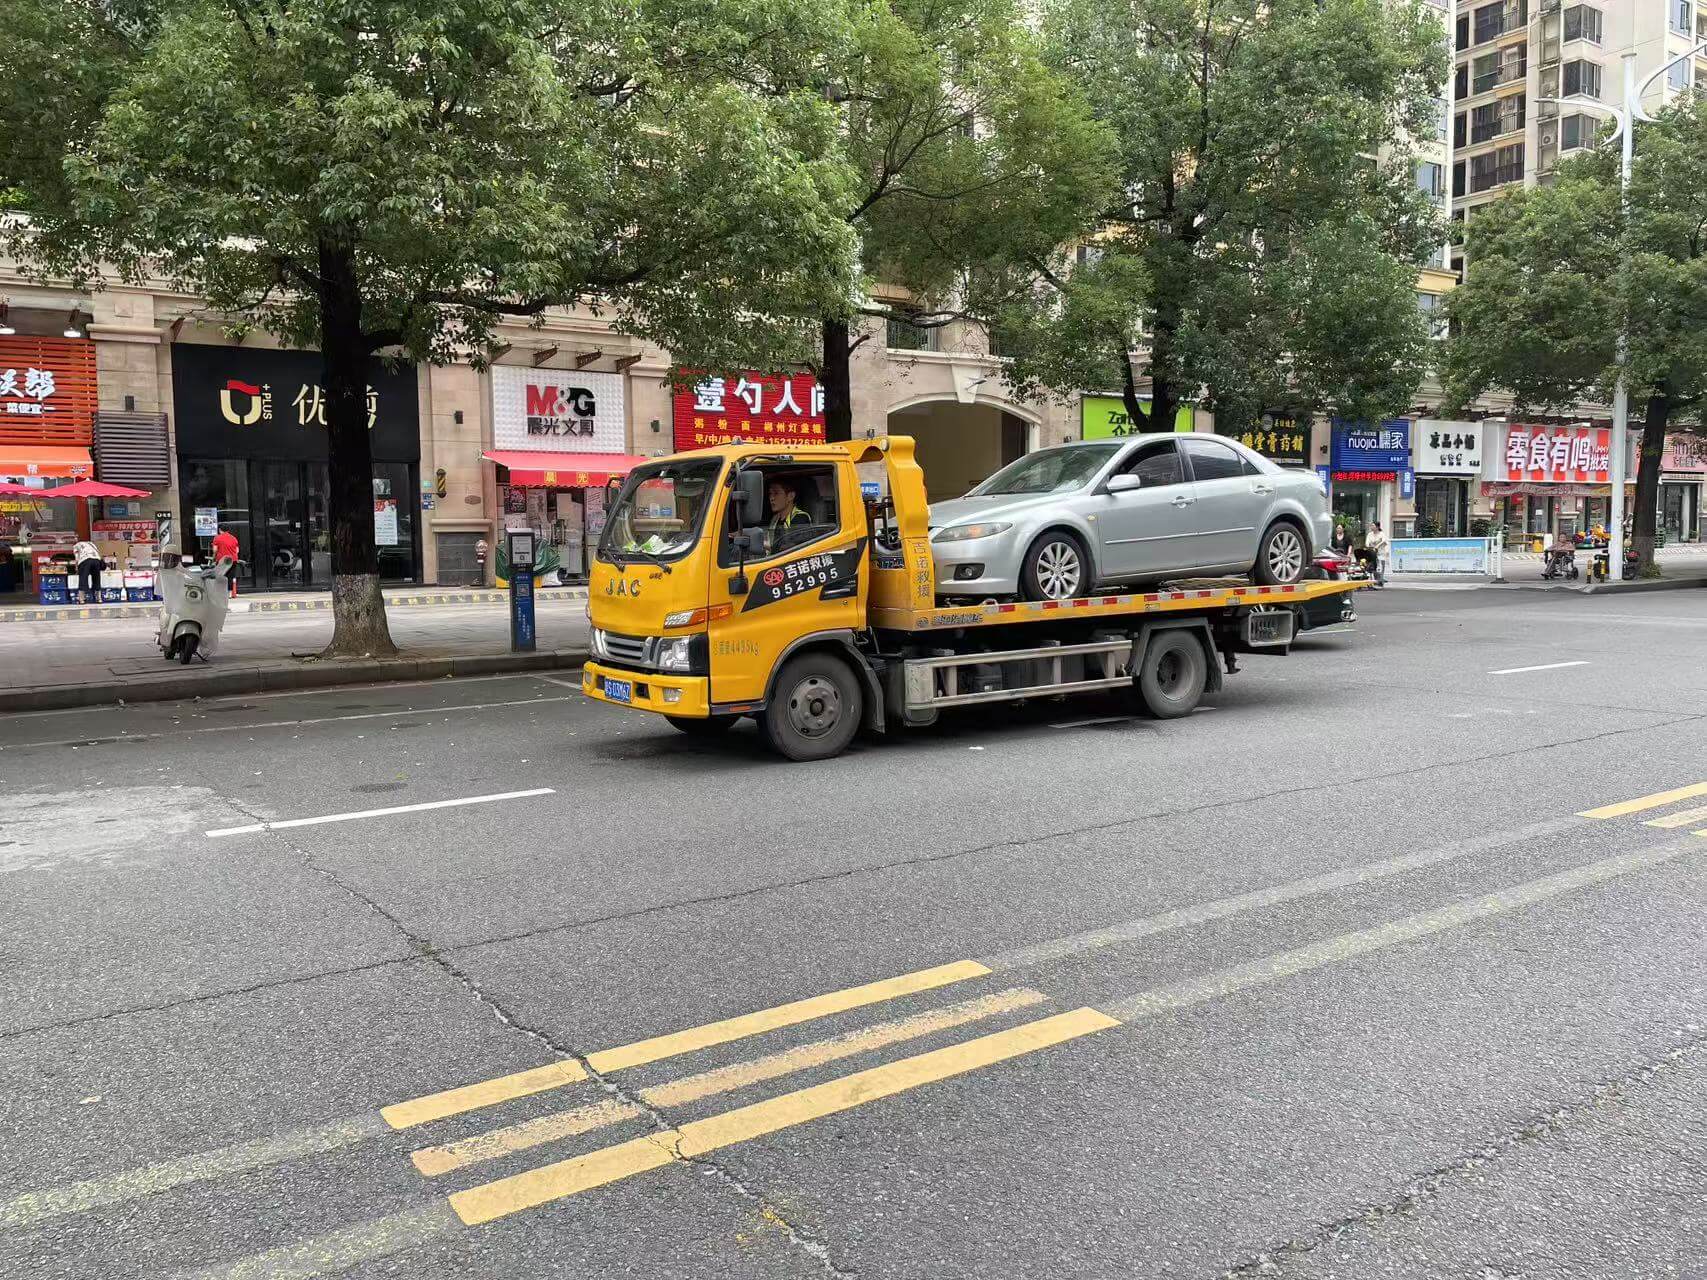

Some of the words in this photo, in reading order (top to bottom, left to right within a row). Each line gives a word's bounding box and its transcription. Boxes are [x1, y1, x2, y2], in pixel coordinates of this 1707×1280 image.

[526, 384, 596, 417] M&G
[527, 417, 595, 437] 晨光文具
[785, 555, 834, 578] 吉诺救援
[605, 578, 641, 598] JAC
[772, 568, 838, 599] 952995
